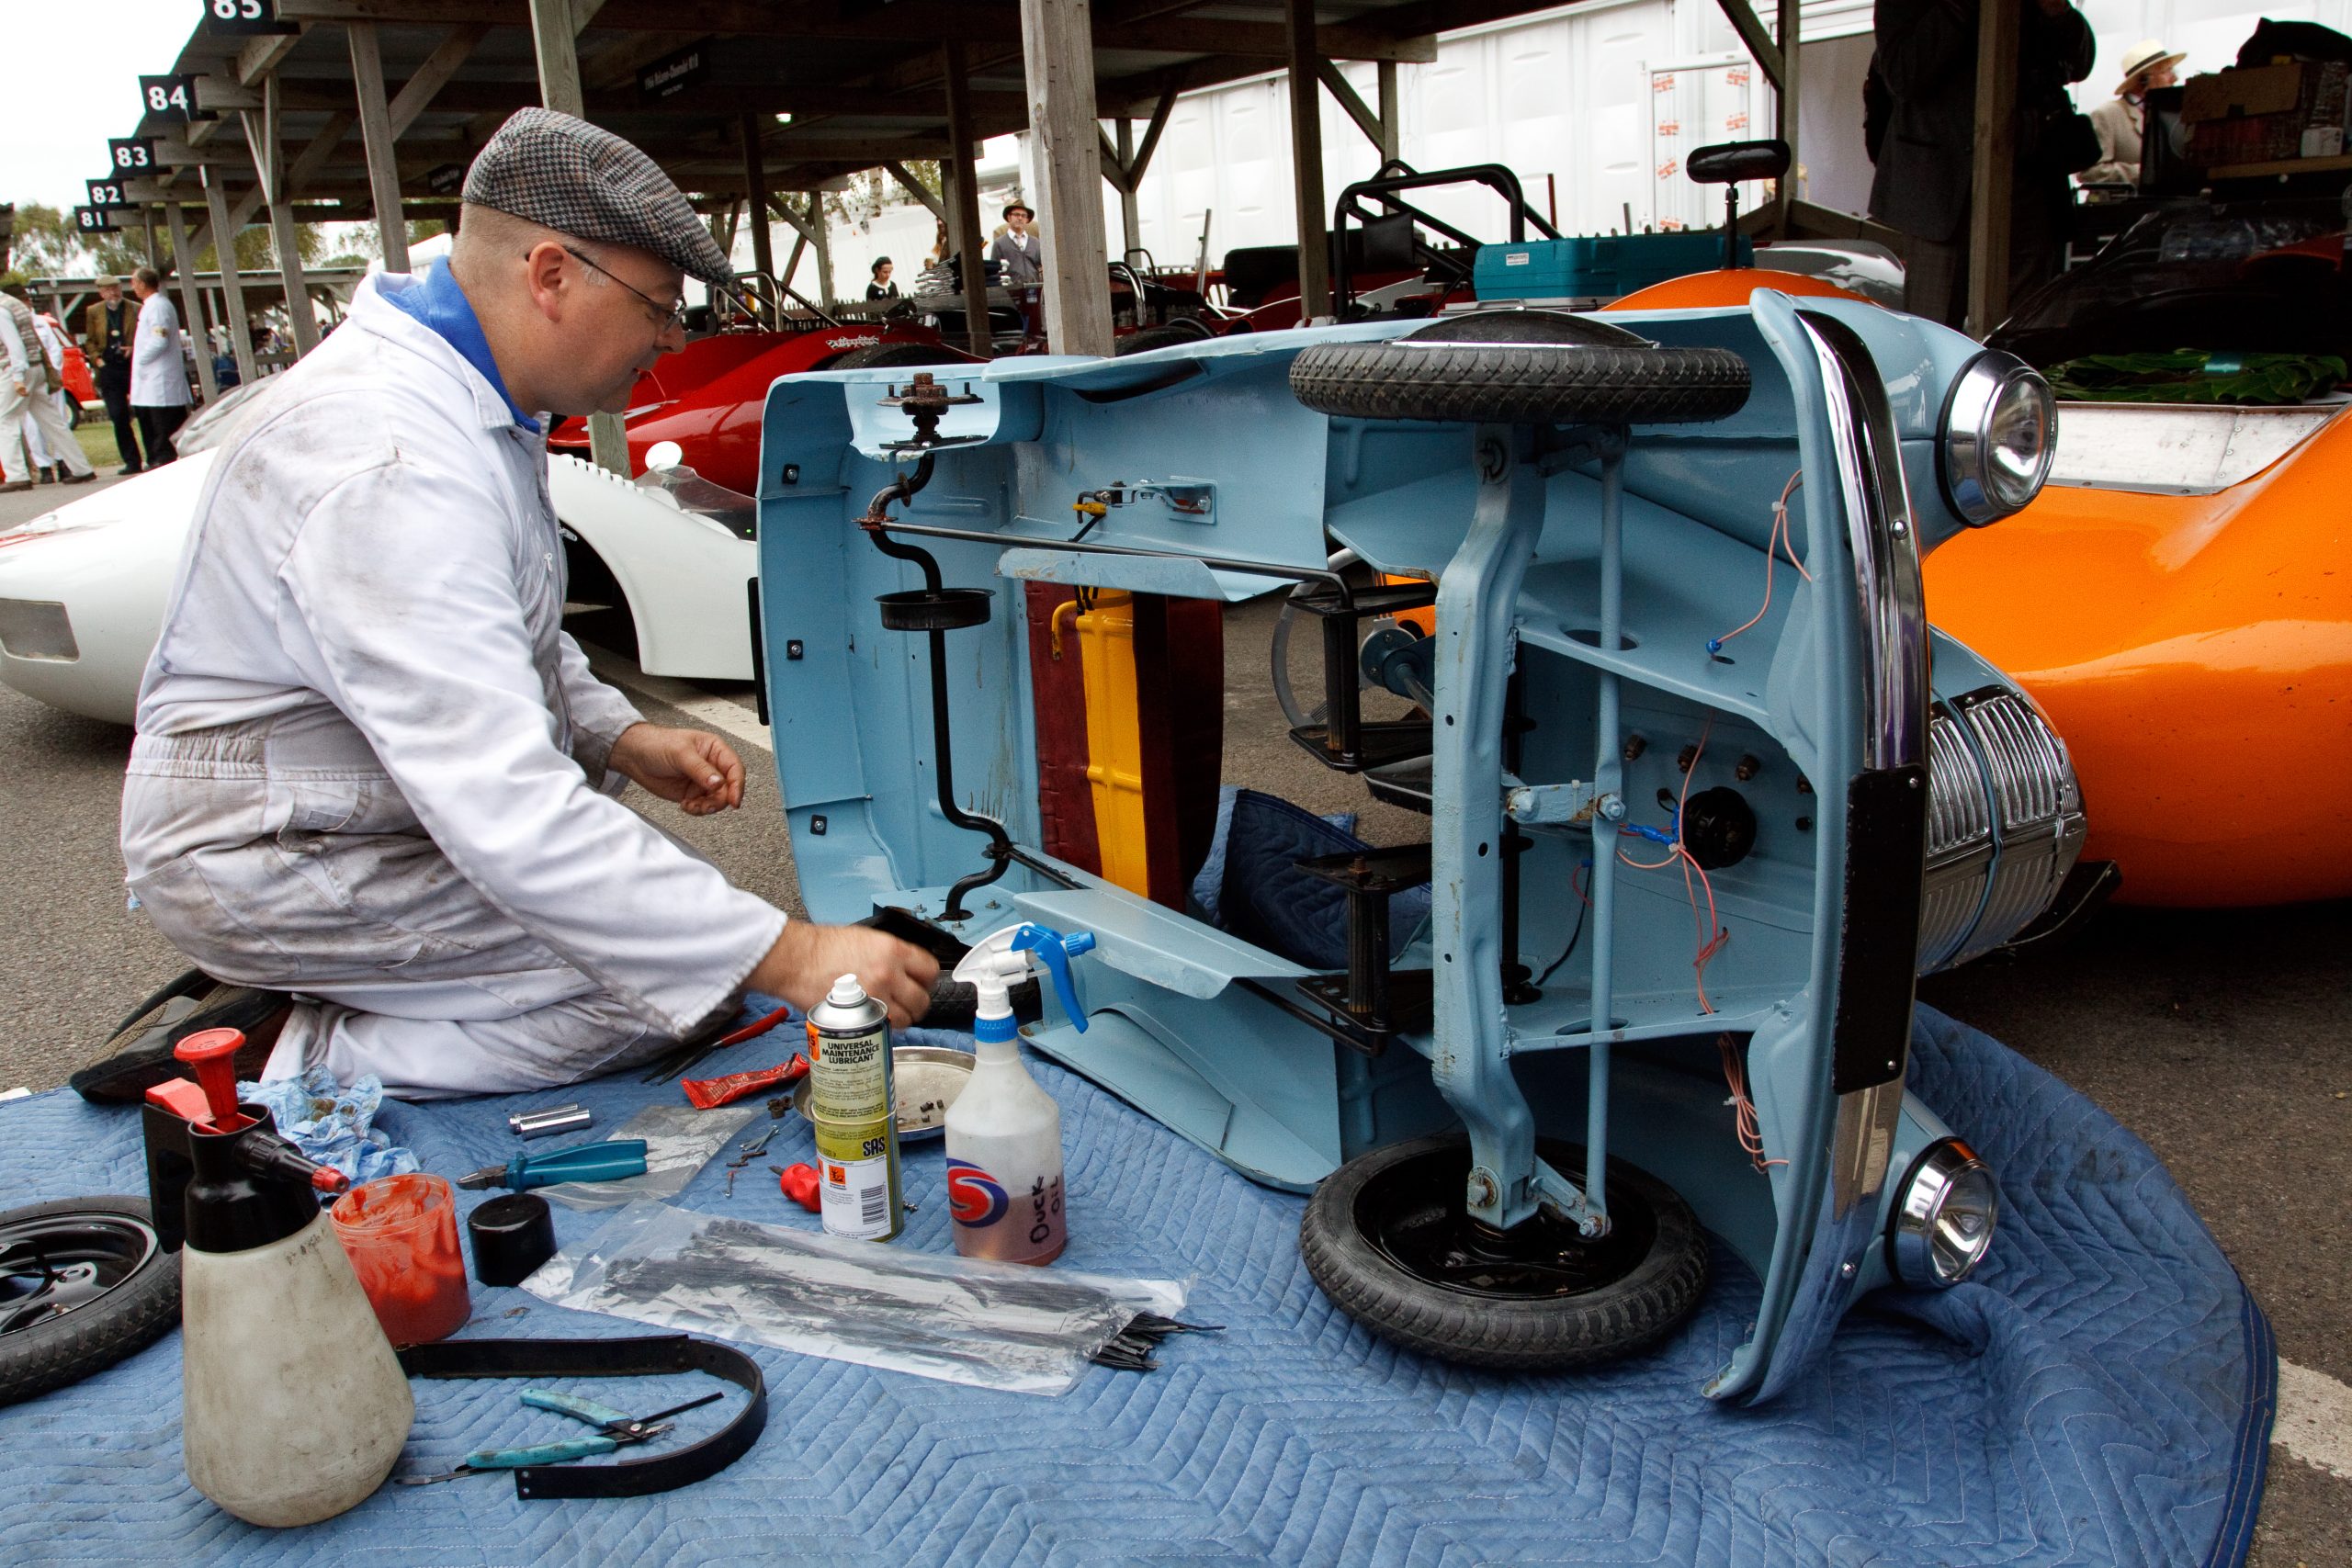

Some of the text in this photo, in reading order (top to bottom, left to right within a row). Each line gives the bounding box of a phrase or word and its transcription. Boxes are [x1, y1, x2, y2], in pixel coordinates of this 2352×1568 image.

[213, 0, 262, 19] 85
[148, 85, 188, 111] 84
[116, 146, 149, 167] 83
[92, 186, 121, 204] 82
[81, 212, 103, 227] 81
[821, 1043, 880, 1057] MAINTENANCE
[827, 1039, 874, 1050] UNIVERSAL
[829, 1053, 875, 1065] LUBRICANT
[862, 1136, 886, 1156] SAS
